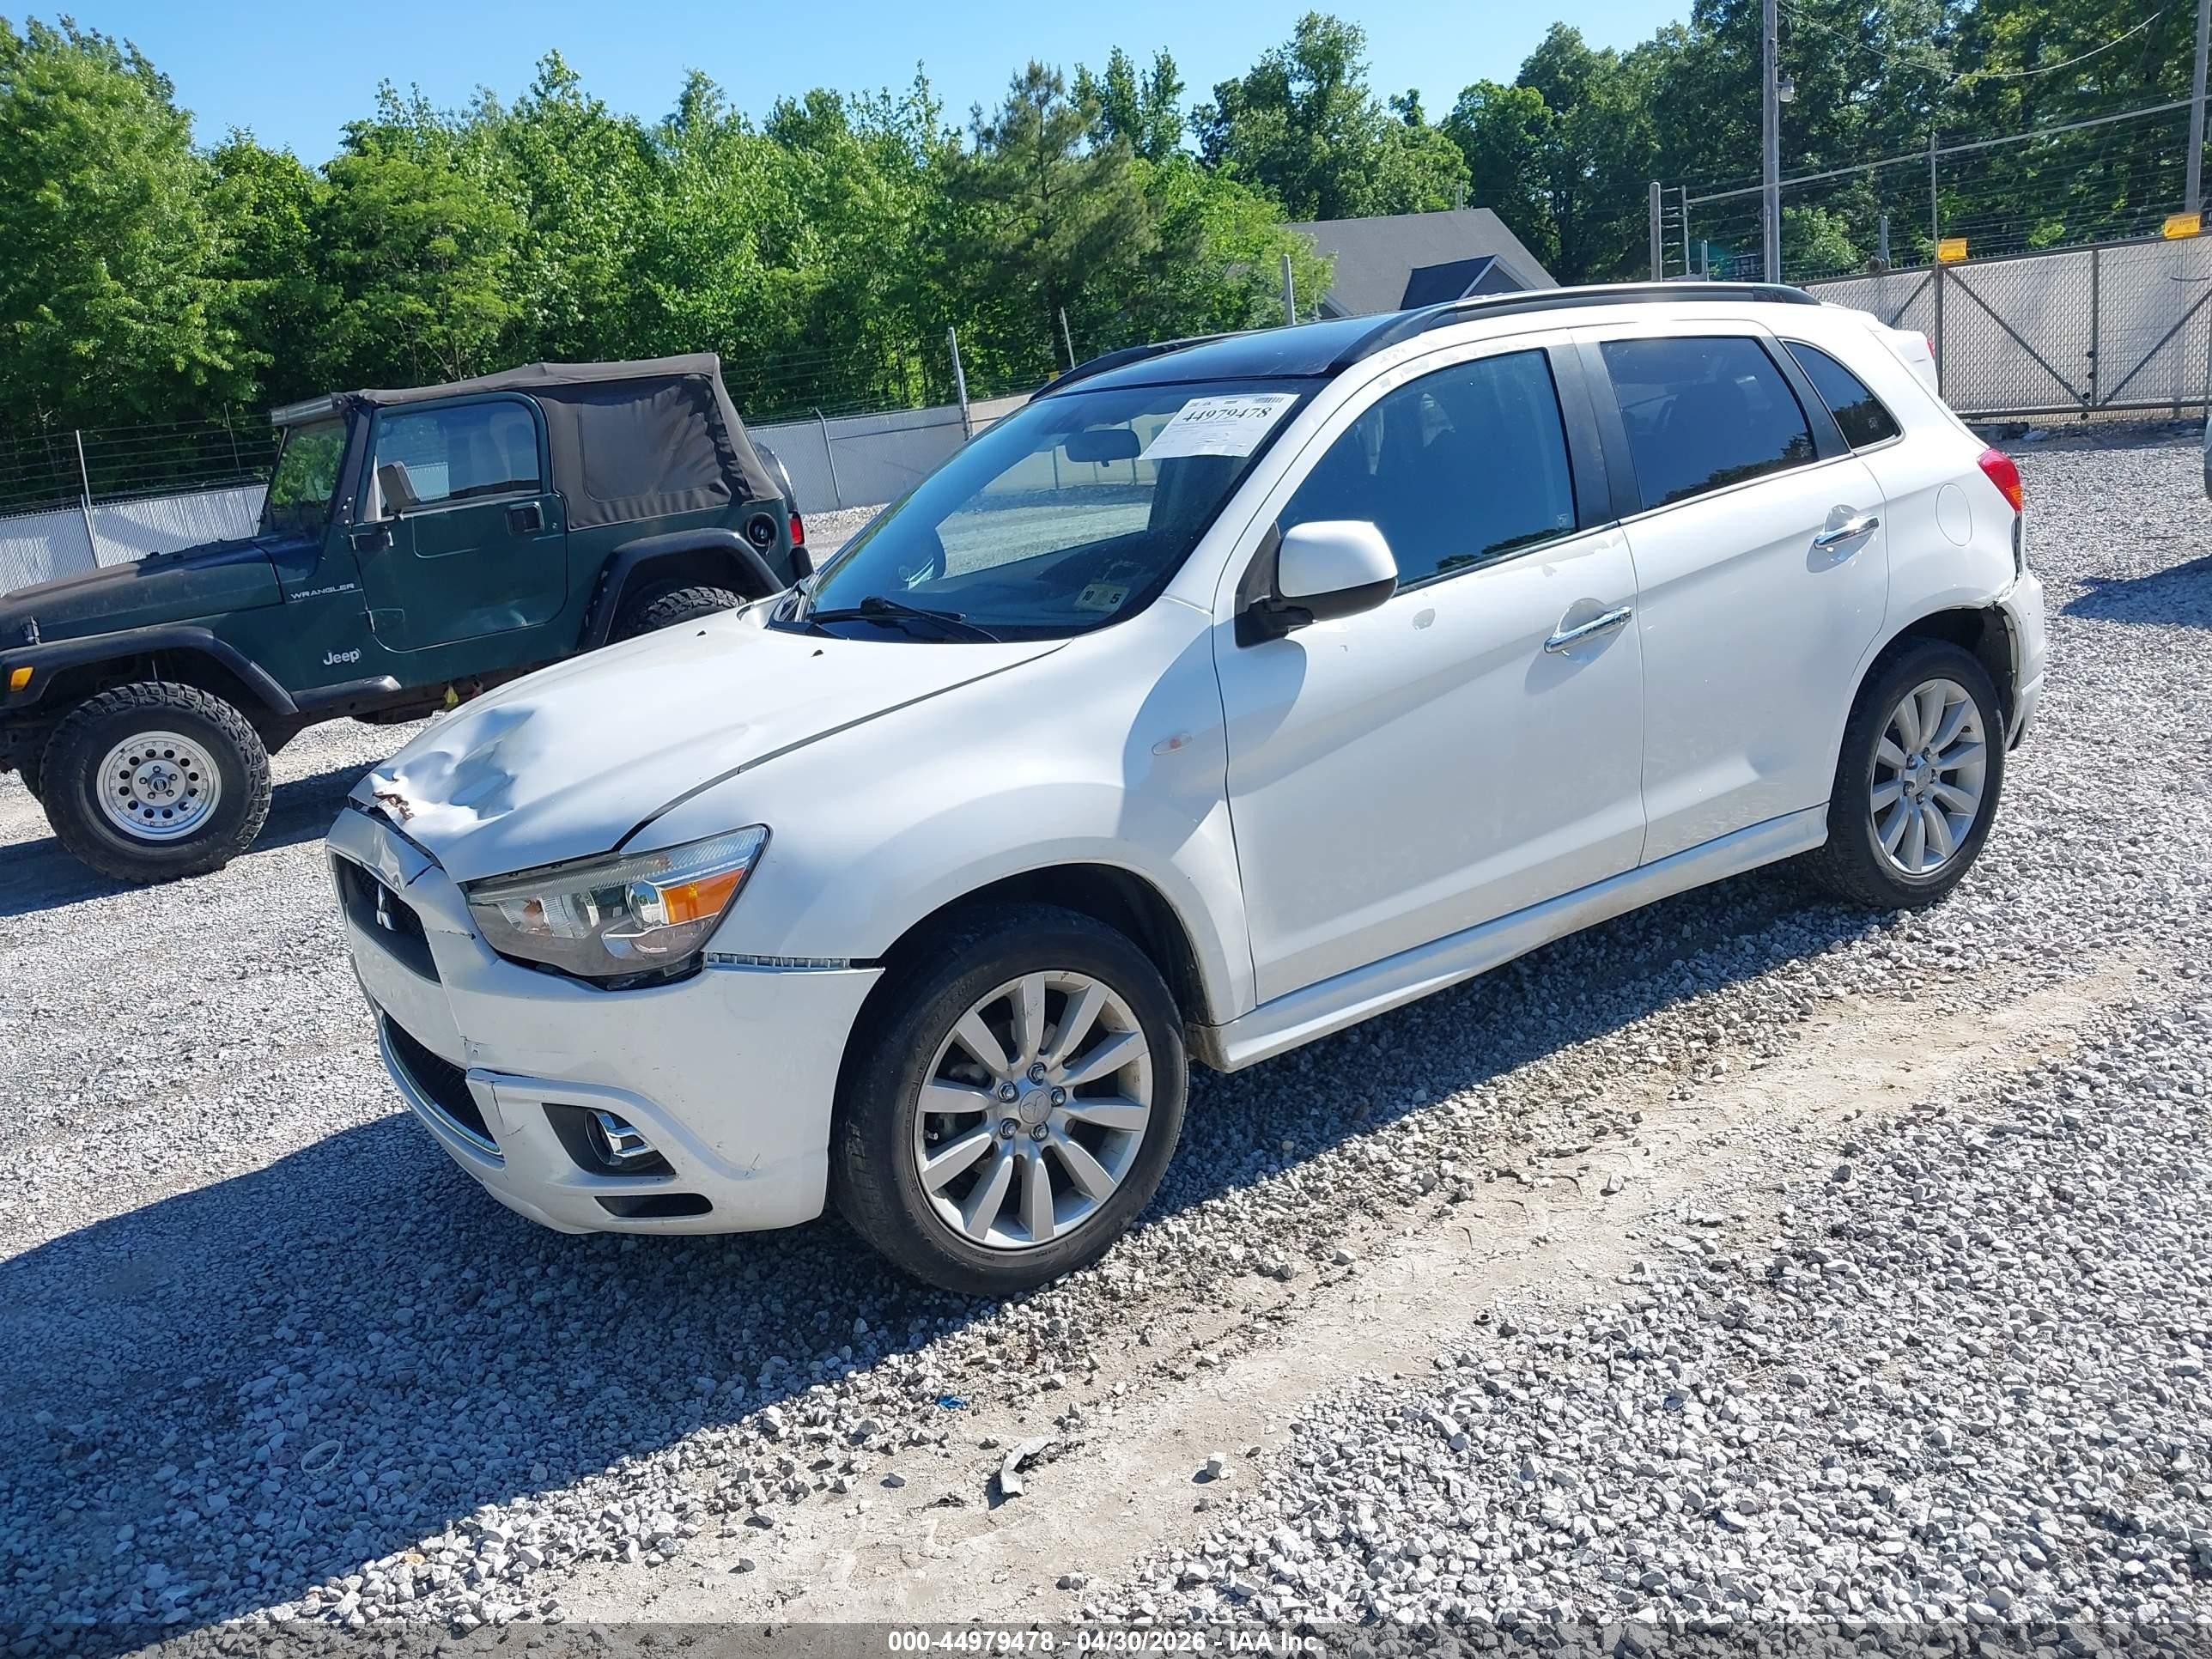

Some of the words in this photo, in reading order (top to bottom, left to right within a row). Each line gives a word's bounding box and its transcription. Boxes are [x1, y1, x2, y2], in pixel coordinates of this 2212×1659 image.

[1182, 406, 1273, 422] 44979478
[290, 583, 355, 599] WRANGLER
[323, 649, 360, 665] Jeep
